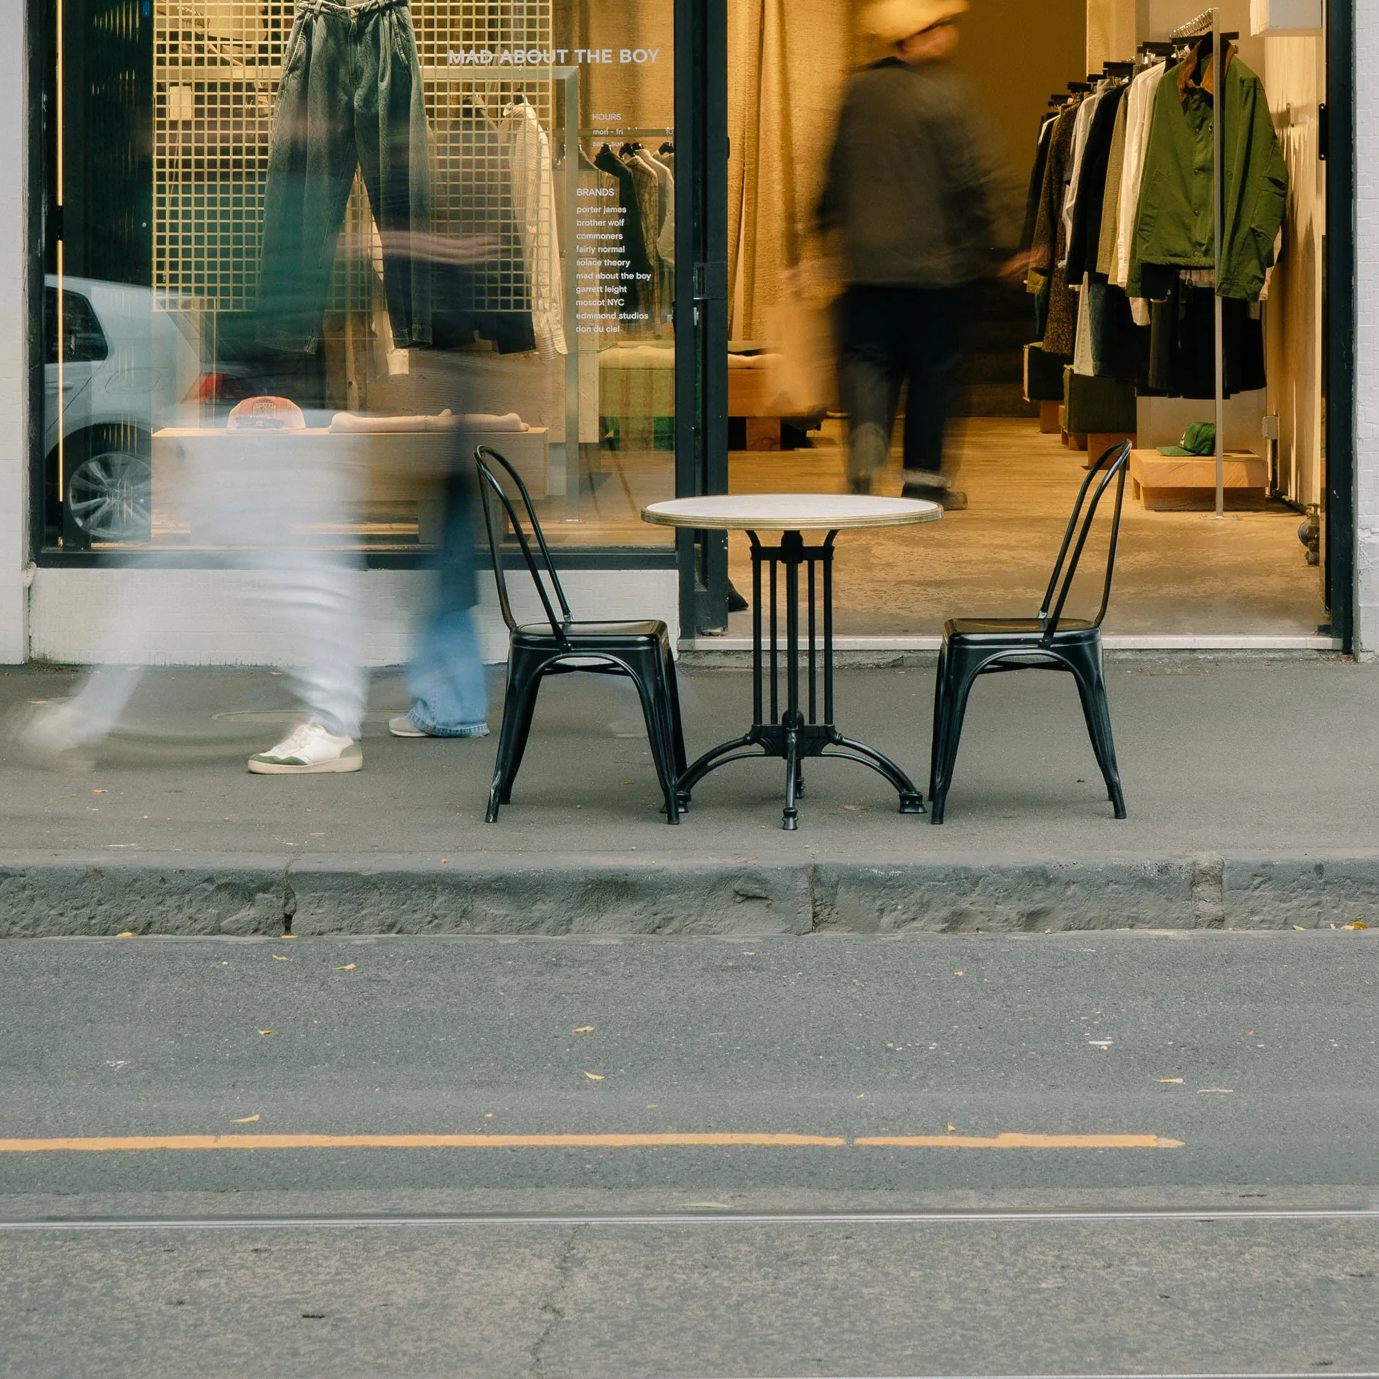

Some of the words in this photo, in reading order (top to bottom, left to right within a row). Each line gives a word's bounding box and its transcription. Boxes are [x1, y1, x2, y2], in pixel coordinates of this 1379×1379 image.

[447, 48, 493, 64] MAD
[499, 48, 569, 64] ABOUT
[573, 48, 612, 64] THE
[618, 48, 660, 64] BOY
[592, 113, 622, 121] HOURS
[576, 188, 615, 197] BRANDS
[576, 207, 601, 215] porter
[603, 206, 627, 215] james
[576, 219, 606, 227] brother
[607, 218, 625, 227] wolf
[576, 245, 596, 254] fairly
[597, 245, 626, 253] normal
[604, 258, 631, 268] theory
[575, 272, 594, 280] mad
[595, 272, 619, 280] about
[620, 272, 635, 280] the
[635, 272, 652, 281] boy
[575, 285, 603, 295] garrett
[604, 285, 628, 295] leight
[607, 298, 625, 306] NYC
[575, 312, 617, 320] edmmond
[618, 312, 649, 320] studios
[575, 325, 591, 333] don
[593, 325, 604, 333] du
[605, 325, 620, 333] ciel
